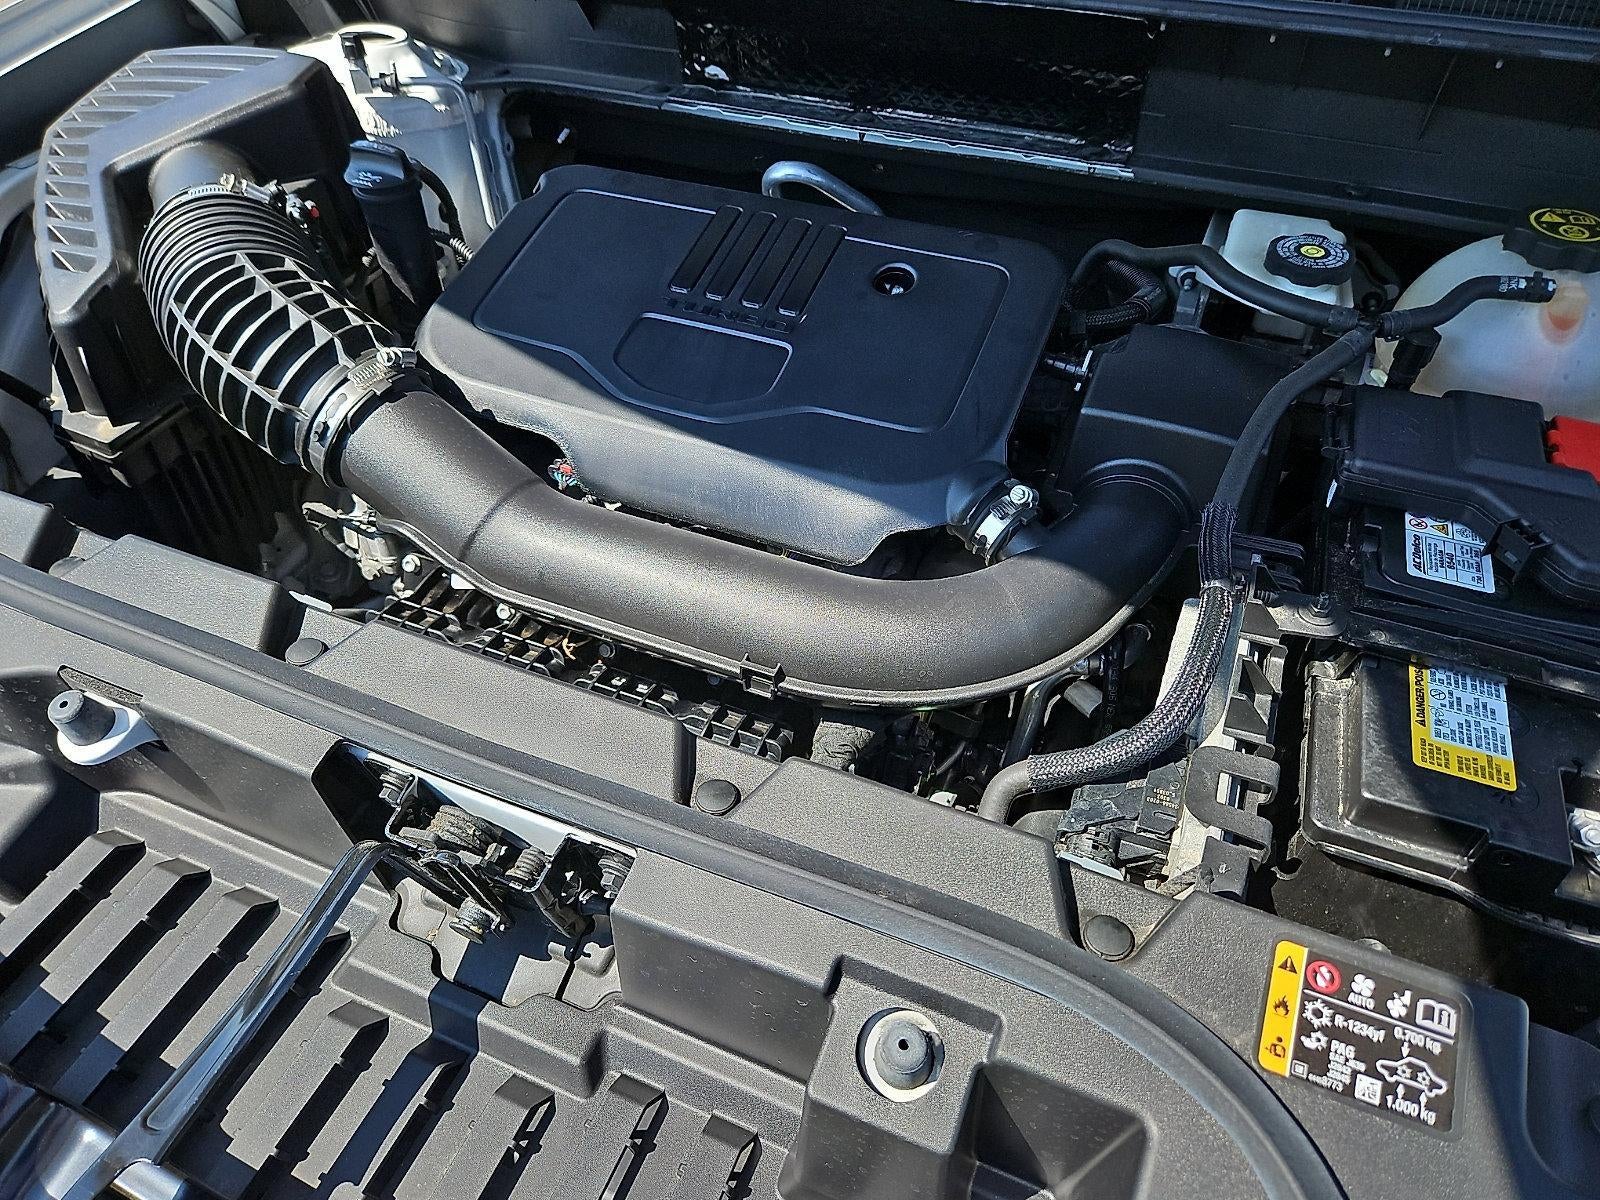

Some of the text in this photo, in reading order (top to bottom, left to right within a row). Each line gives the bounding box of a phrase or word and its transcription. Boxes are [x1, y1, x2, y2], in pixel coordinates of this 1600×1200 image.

[662, 296, 797, 335] TURBO
[1347, 992, 1375, 1010] AUTO
[1334, 1014, 1386, 1044] R-1234yf
[1394, 1026, 1426, 1048] 0.700
[1330, 1039, 1356, 1060] PAG
[1386, 1095, 1437, 1126] 1.000 kg
